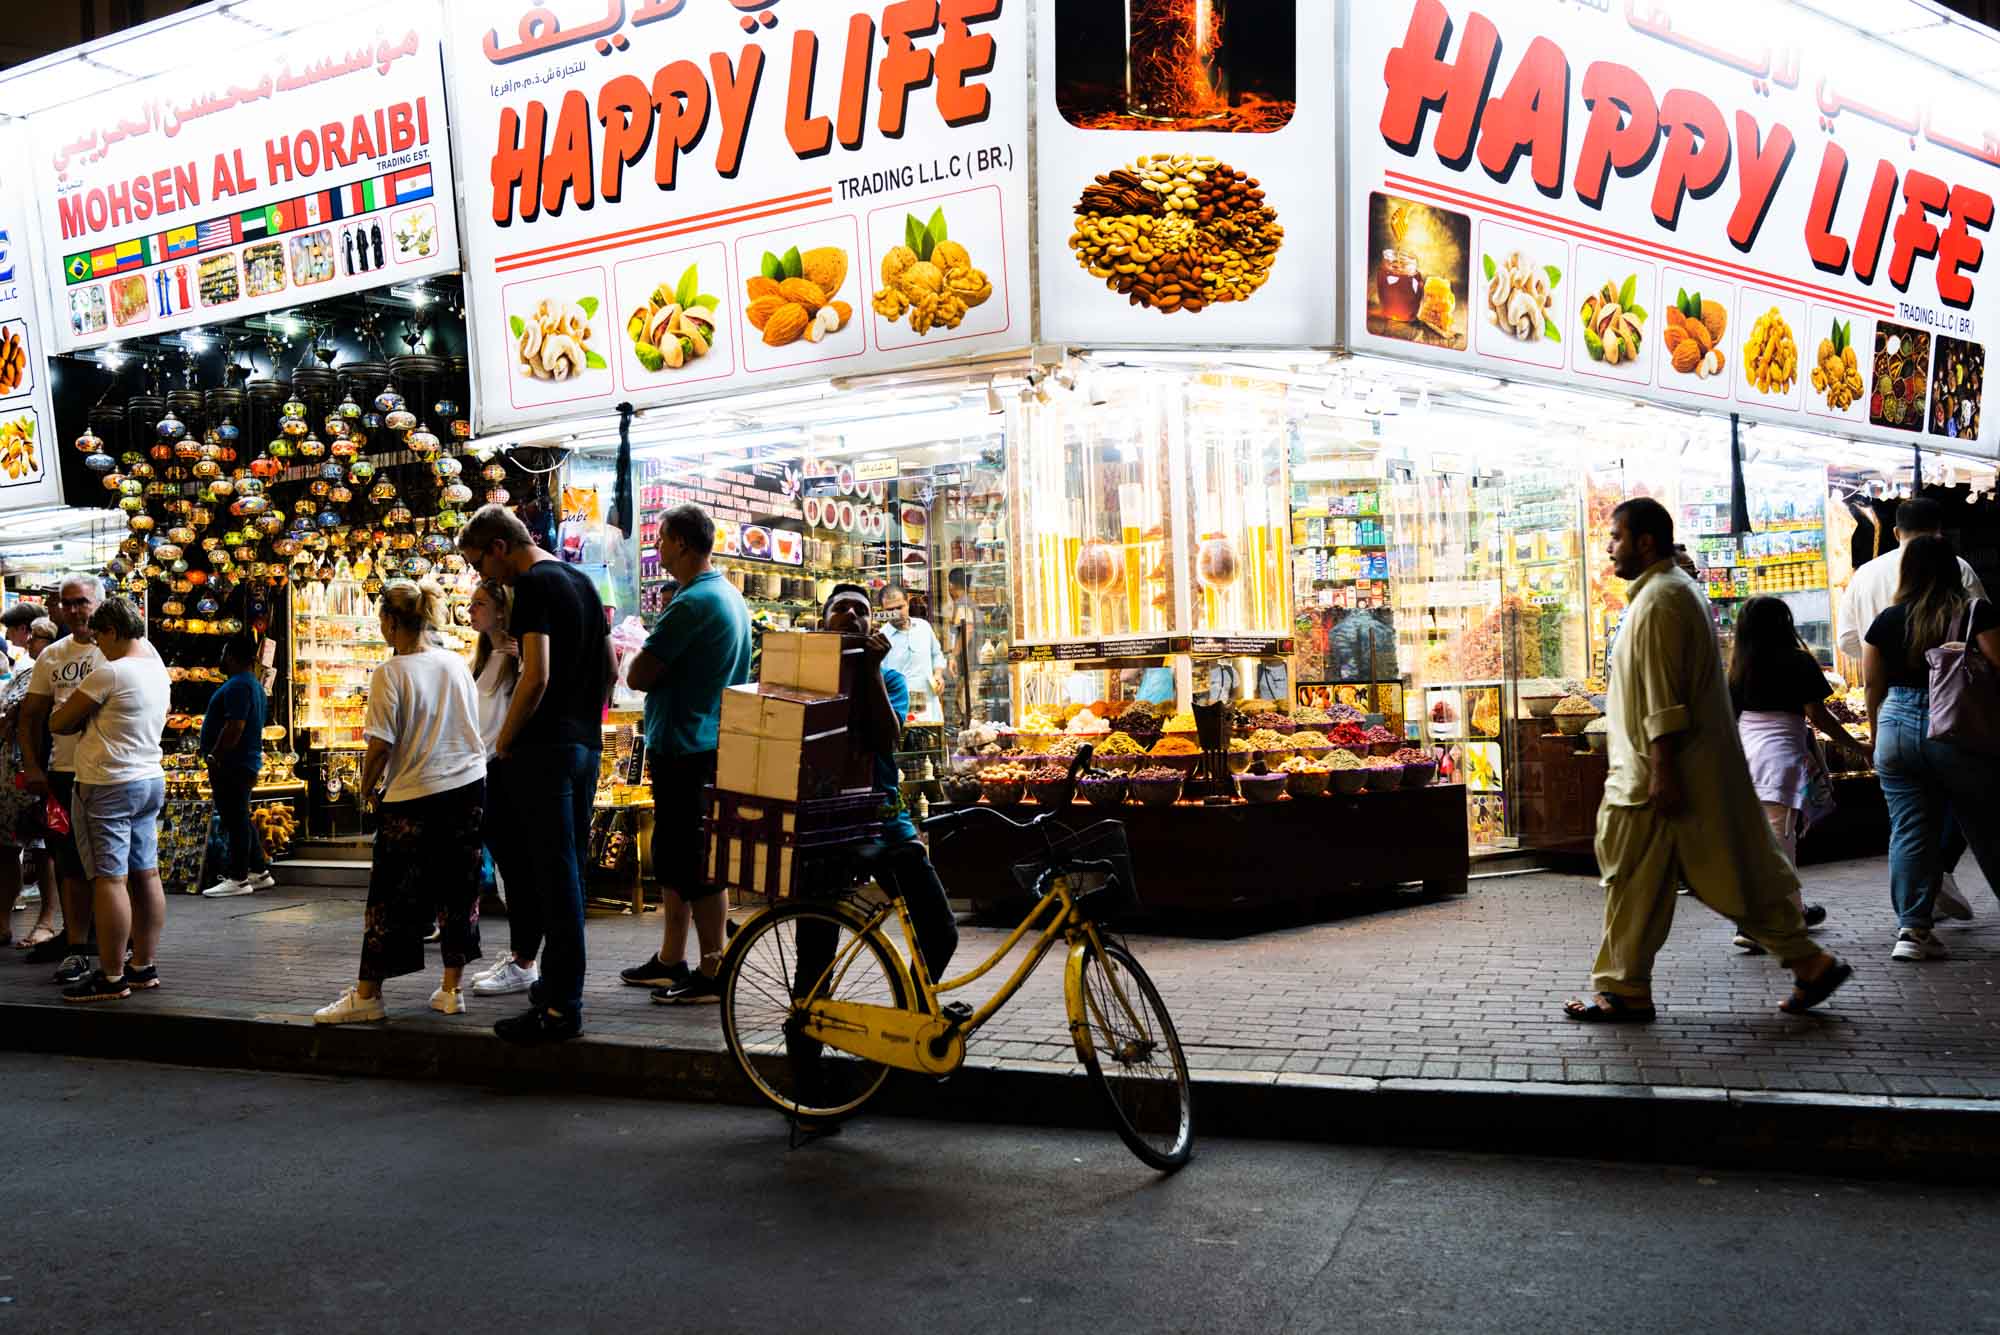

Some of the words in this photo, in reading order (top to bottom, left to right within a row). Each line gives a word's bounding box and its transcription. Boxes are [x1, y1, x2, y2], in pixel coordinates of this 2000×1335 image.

[491, 43, 765, 228] HAPPY
[784, 0, 1002, 160] LIFE
[58, 161, 200, 240] MOHSEN
[212, 148, 257, 200] AL
[266, 96, 430, 185] HORAIBI
[376, 154, 411, 171] TRADING
[413, 149, 430, 161] EST.
[838, 165, 914, 201] TRADING
[919, 155, 961, 184] L.L.C
[1378, 0, 1796, 253] HAPPY
[1804, 140, 1994, 310] LIFE
[1899, 302, 1934, 325] TRADING
[1935, 311, 1954, 330] L.L.C
[52, 661, 93, 682] s.Oli
